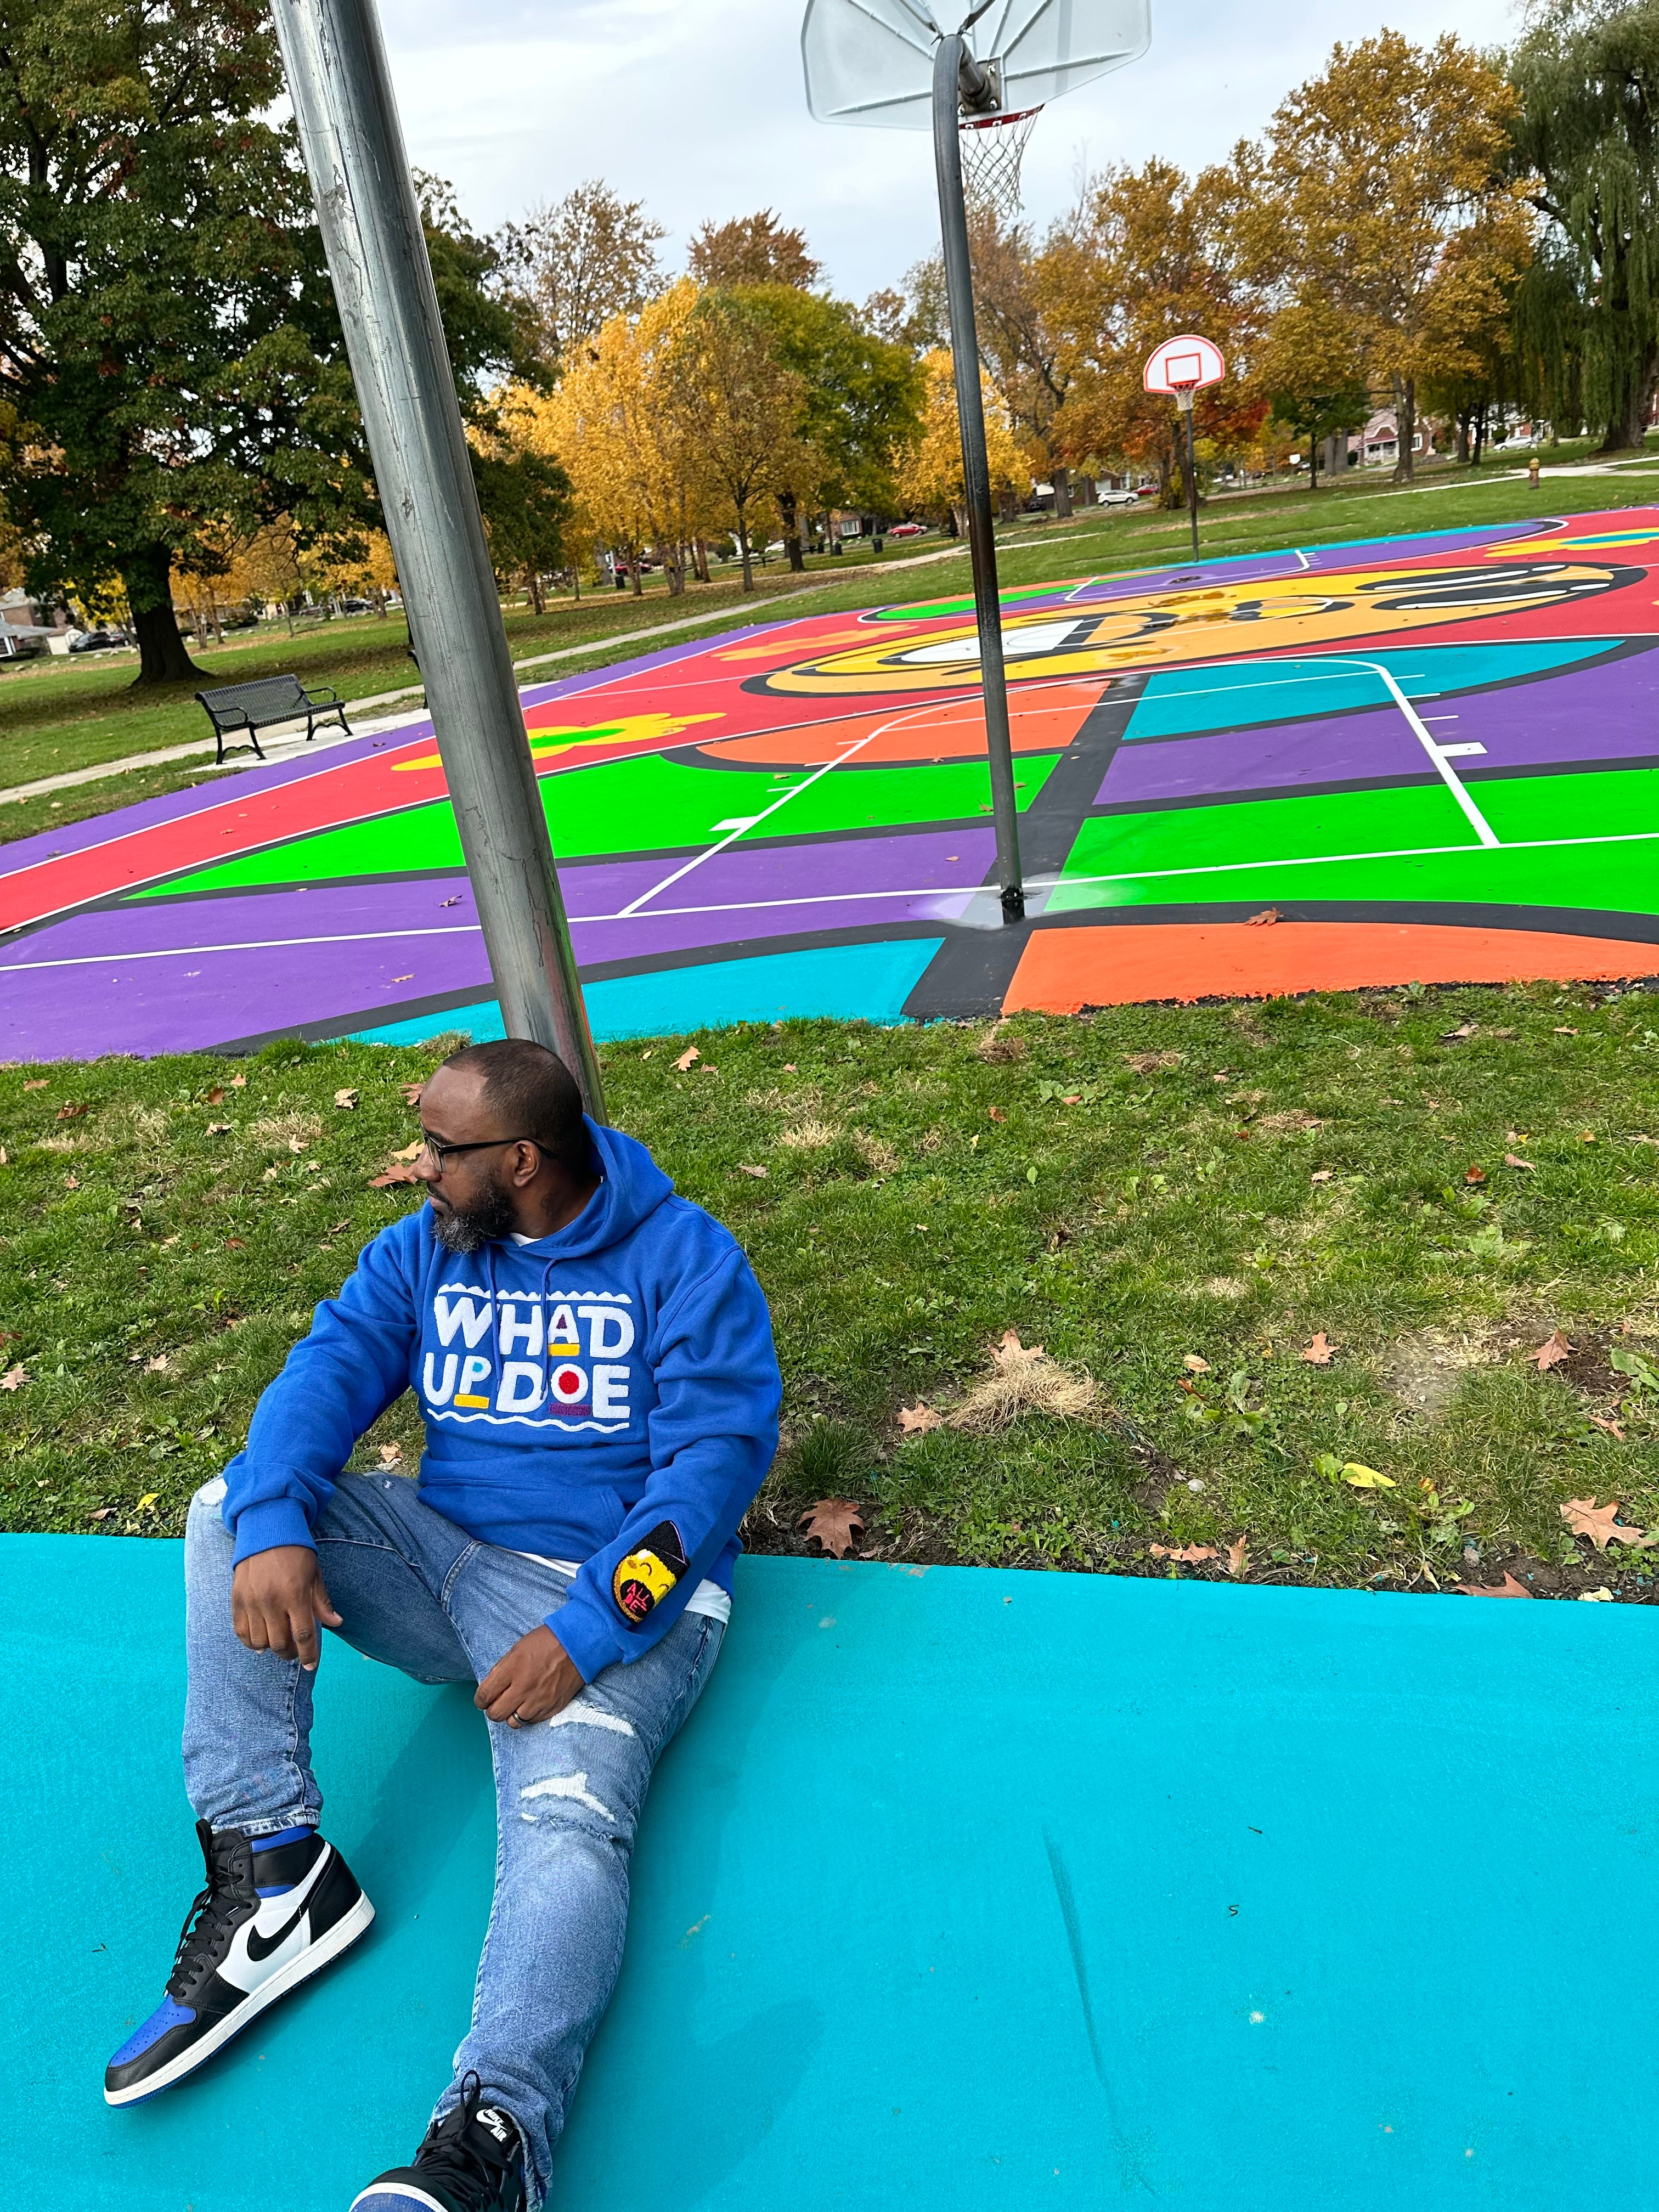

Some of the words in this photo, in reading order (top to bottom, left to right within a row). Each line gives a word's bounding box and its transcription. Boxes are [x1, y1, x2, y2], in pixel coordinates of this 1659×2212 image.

[423, 1352, 492, 1406] UP
[496, 1361, 631, 1419] DOE
[484, 2109, 505, 2124] NIKE
[490, 2126, 507, 2142] AIR
